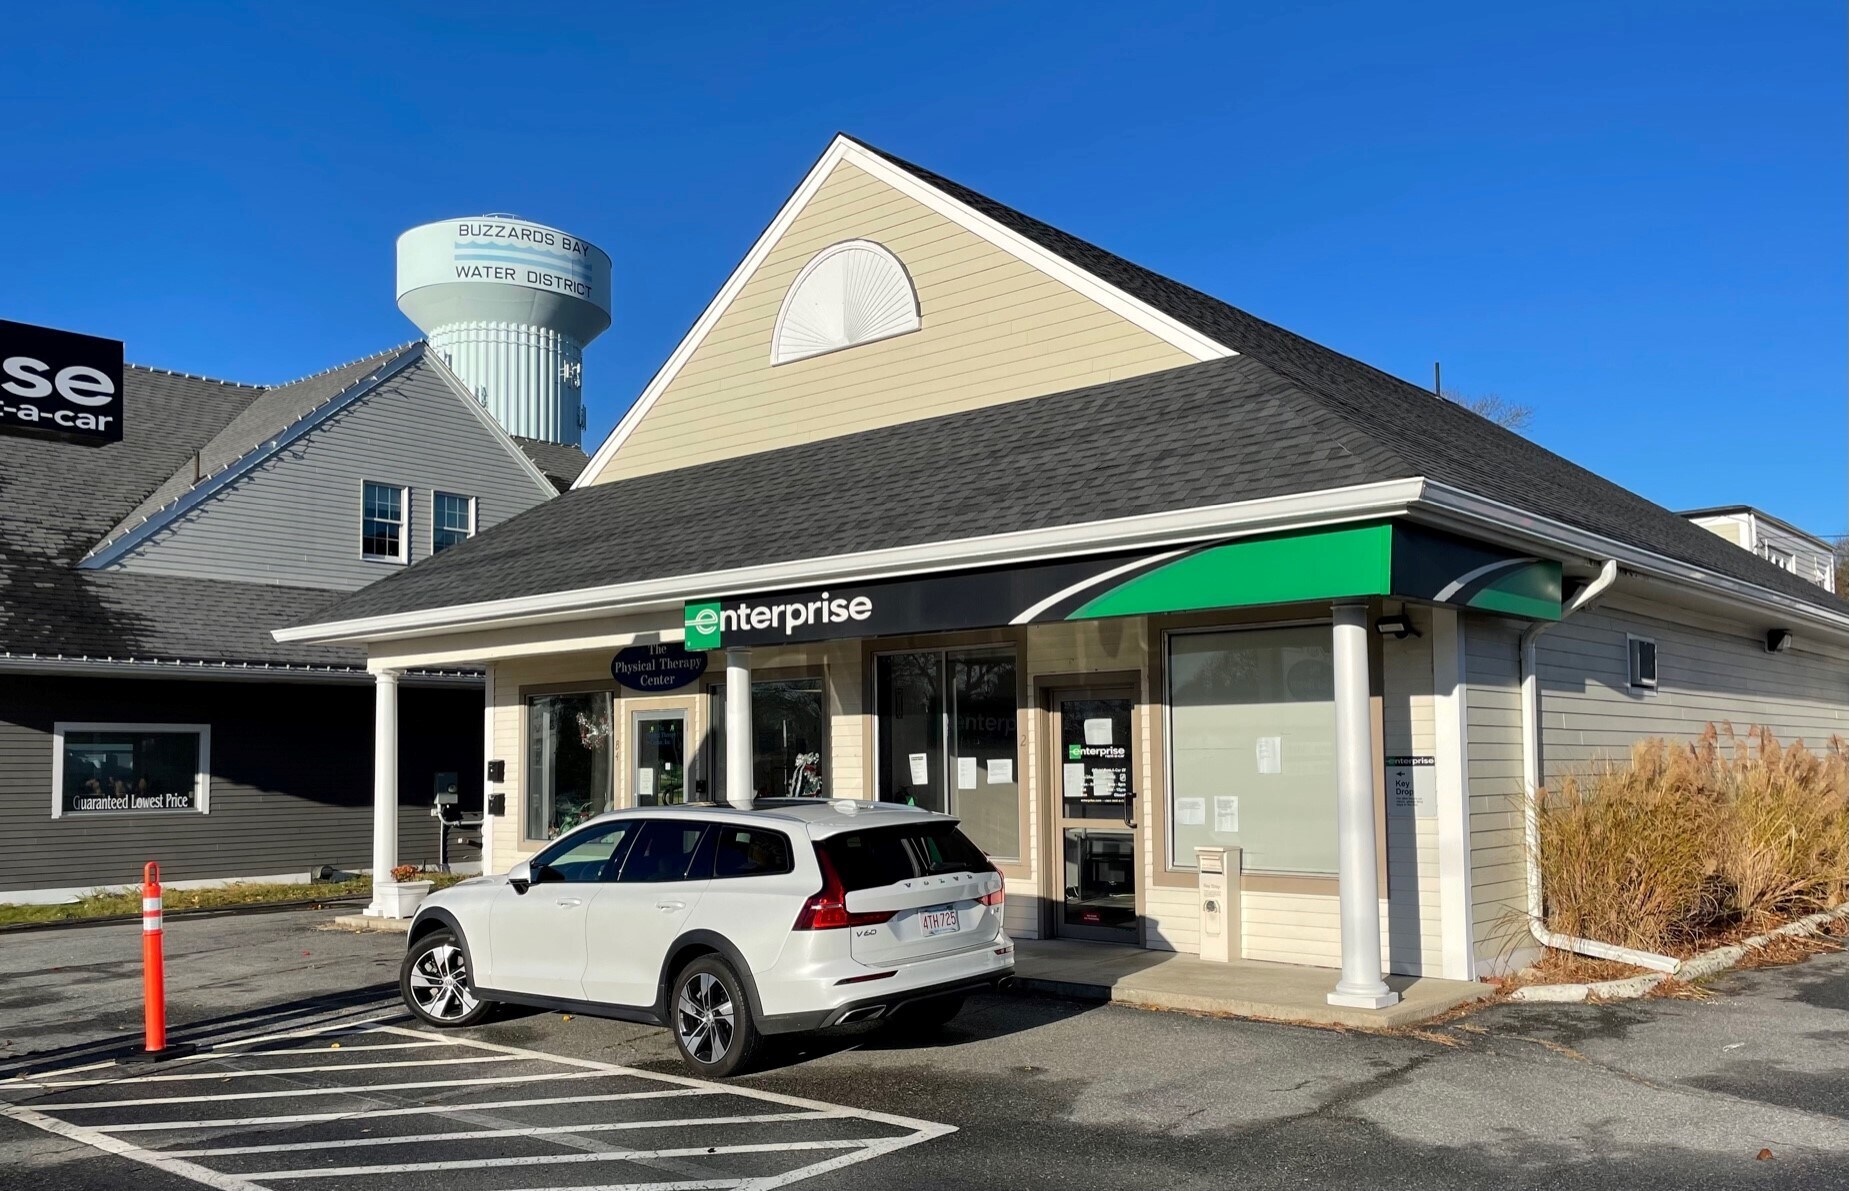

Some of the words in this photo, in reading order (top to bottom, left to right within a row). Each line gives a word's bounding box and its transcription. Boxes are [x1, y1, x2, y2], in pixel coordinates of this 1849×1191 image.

[459, 224, 555, 246] BUZZARDS
[562, 237, 589, 257] BAY
[455, 266, 516, 280] WATER
[527, 270, 592, 298] DISTRICT
[693, 591, 872, 635] enterprise
[648, 643, 667, 656] The
[615, 659, 656, 674] Physical
[659, 657, 702, 670] Therapy
[640, 674, 676, 686] Center
[1071, 746, 1125, 757] enterprise
[1395, 780, 1410, 788] Key
[1395, 788, 1414, 796] Drop
[73, 794, 129, 810] Guaranteed
[131, 794, 164, 809] Lowest
[165, 793, 188, 808] Price
[923, 914, 939, 930] 4TH
[940, 911, 957, 927] 725
[856, 929, 877, 938] V60
